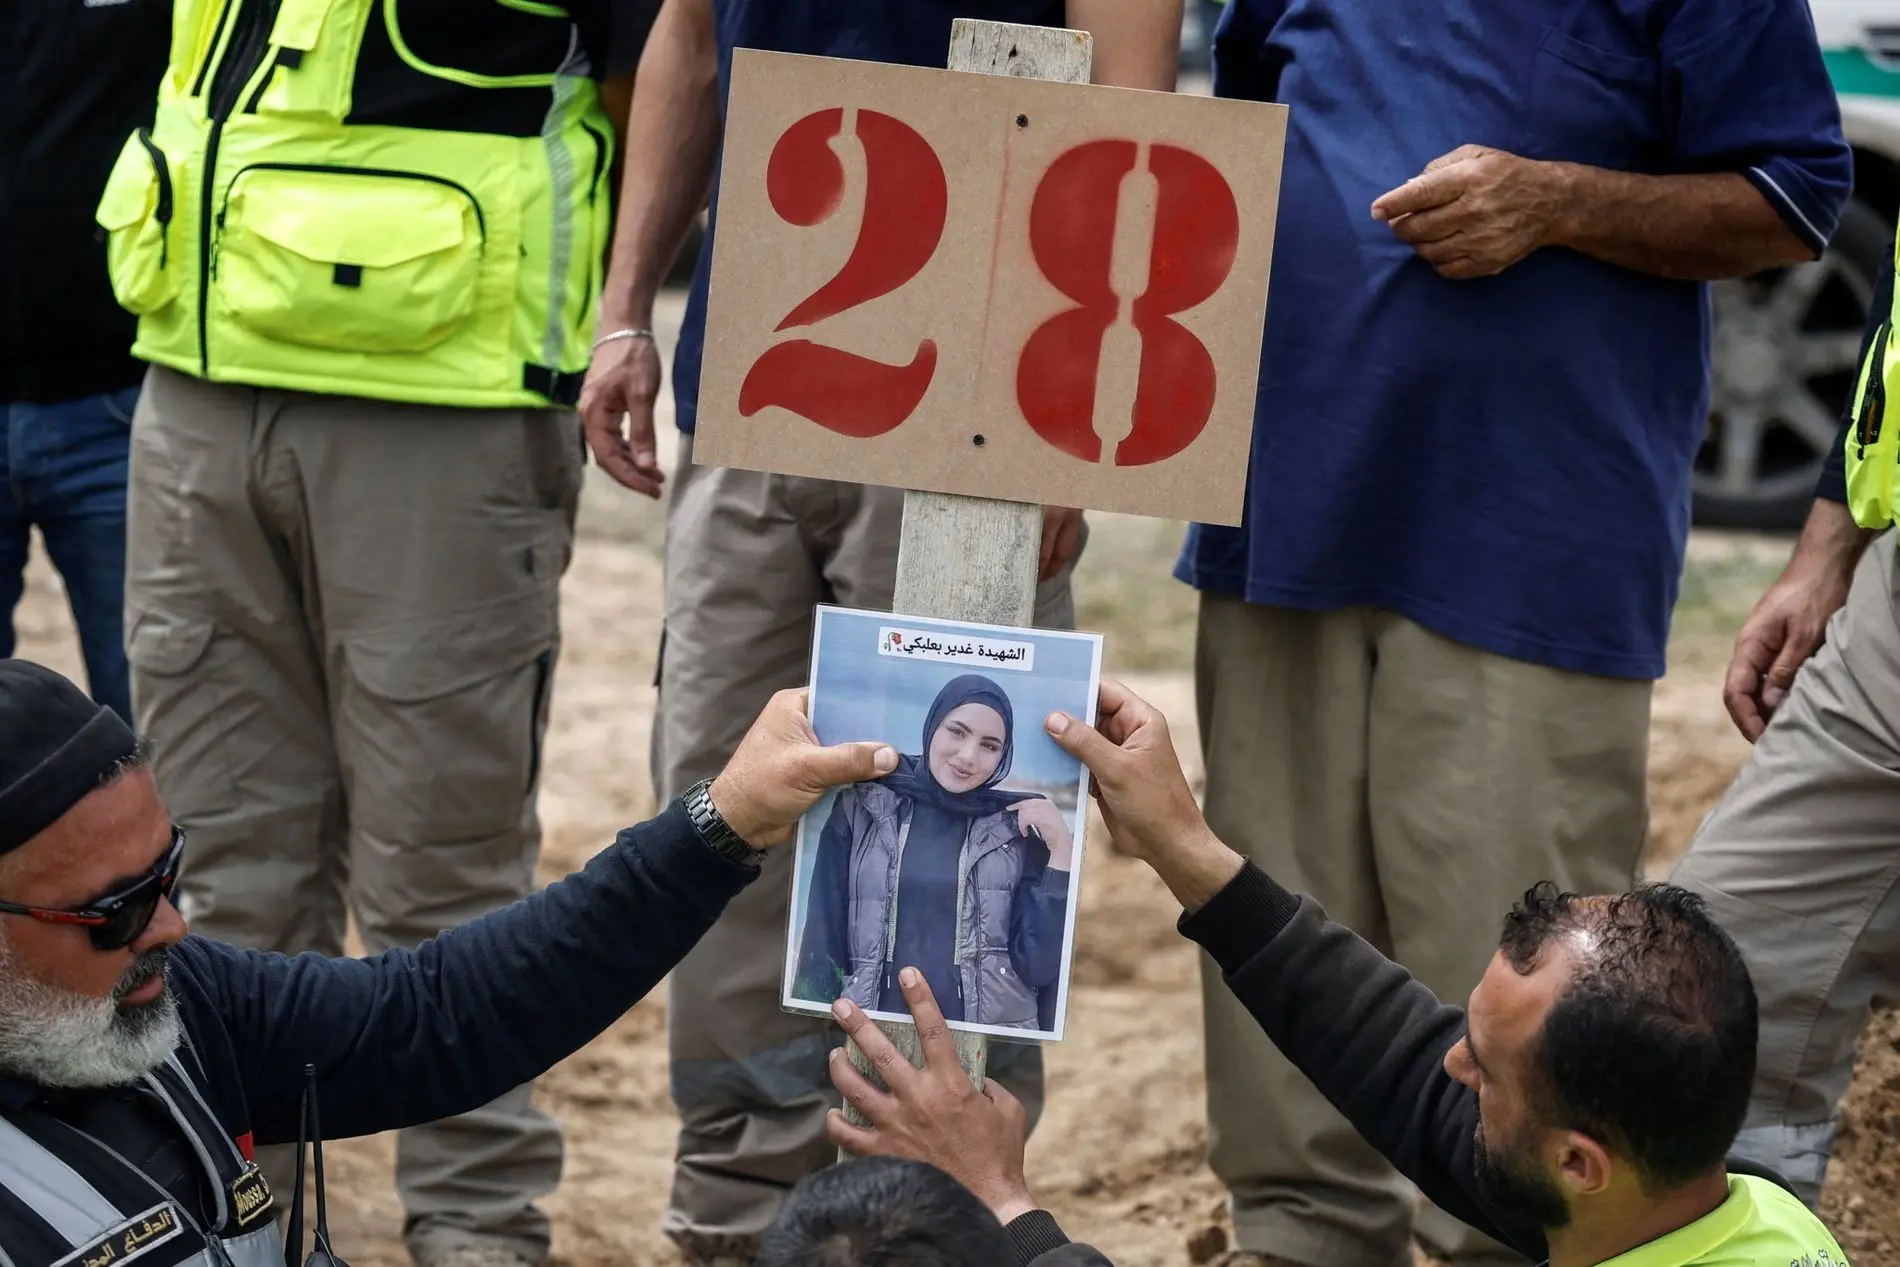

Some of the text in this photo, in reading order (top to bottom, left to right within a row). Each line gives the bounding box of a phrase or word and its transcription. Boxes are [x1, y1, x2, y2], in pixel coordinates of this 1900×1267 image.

[738, 107, 1239, 467] 28
[903, 636, 1026, 661] الشهيدة غدير بعلبكي
[124, 1210, 172, 1254] الدفاع
